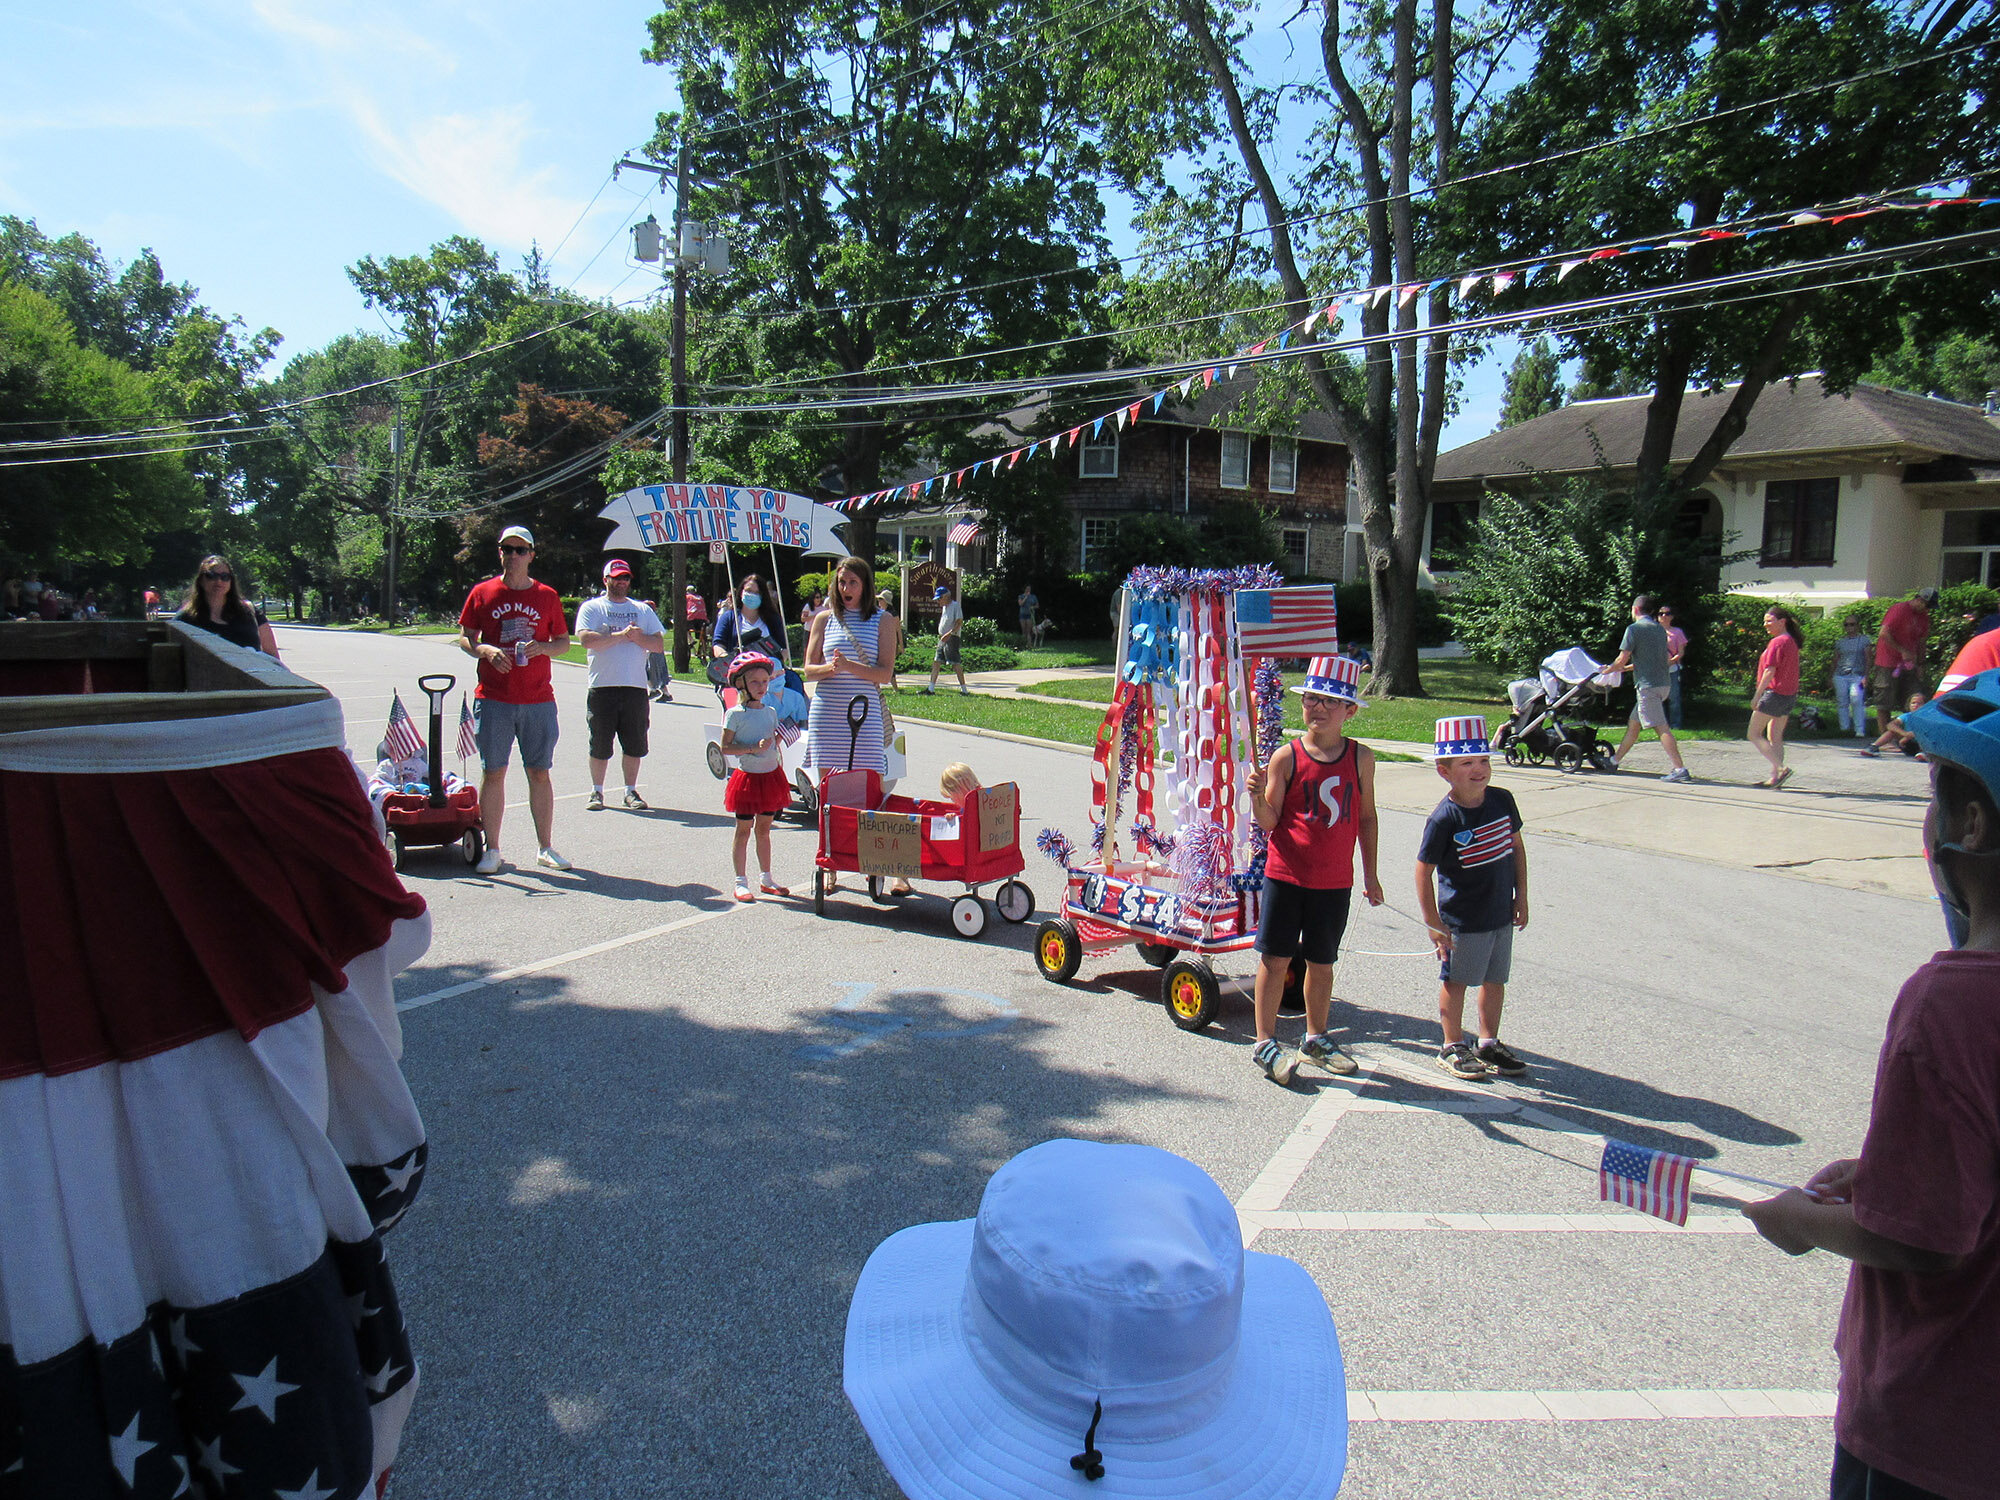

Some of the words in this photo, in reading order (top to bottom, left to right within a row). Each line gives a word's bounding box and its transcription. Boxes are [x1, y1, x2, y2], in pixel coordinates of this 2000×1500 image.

[644, 485, 741, 510] THANK
[748, 489, 787, 513] YOU
[636, 508, 740, 546] FRONTLINE
[747, 511, 810, 548] HEROES
[910, 564, 955, 586] Swarthmore
[492, 603, 512, 619] OLD
[514, 602, 541, 621] NAVY
[981, 792, 1012, 811] PEOPLE
[1303, 776, 1353, 829] USA
[858, 811, 918, 835] HEALTHCARE
[995, 813, 1006, 826] NOT
[874, 836, 885, 849] IS
[892, 838, 899, 850] A
[862, 859, 894, 875] HUMAN
[898, 863, 920, 876] RIGHT
